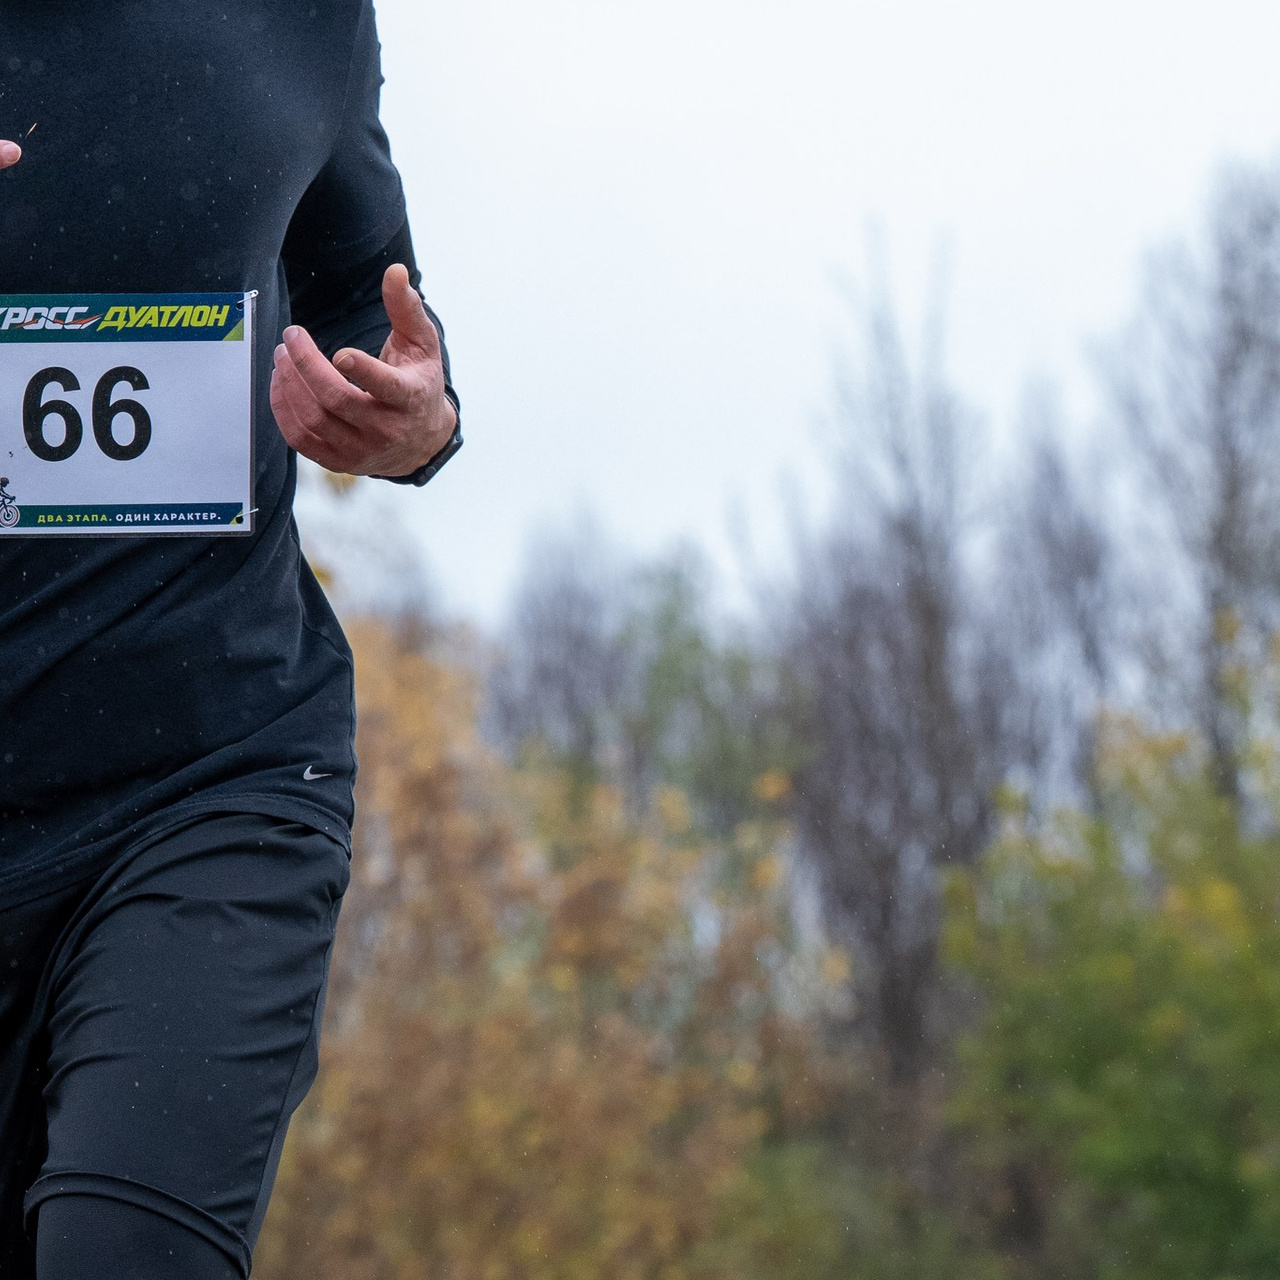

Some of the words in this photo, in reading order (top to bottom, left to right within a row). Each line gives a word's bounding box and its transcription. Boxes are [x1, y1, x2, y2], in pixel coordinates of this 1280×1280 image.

[96, 305, 230, 333] ДУАТЛОН
[22, 365, 152, 463] 66
[37, 514, 63, 523] ДВА
[66, 513, 113, 522] ЭТАПА.
[115, 513, 151, 522] ОДИН
[153, 512, 222, 521] ХАРАКТЕР.
